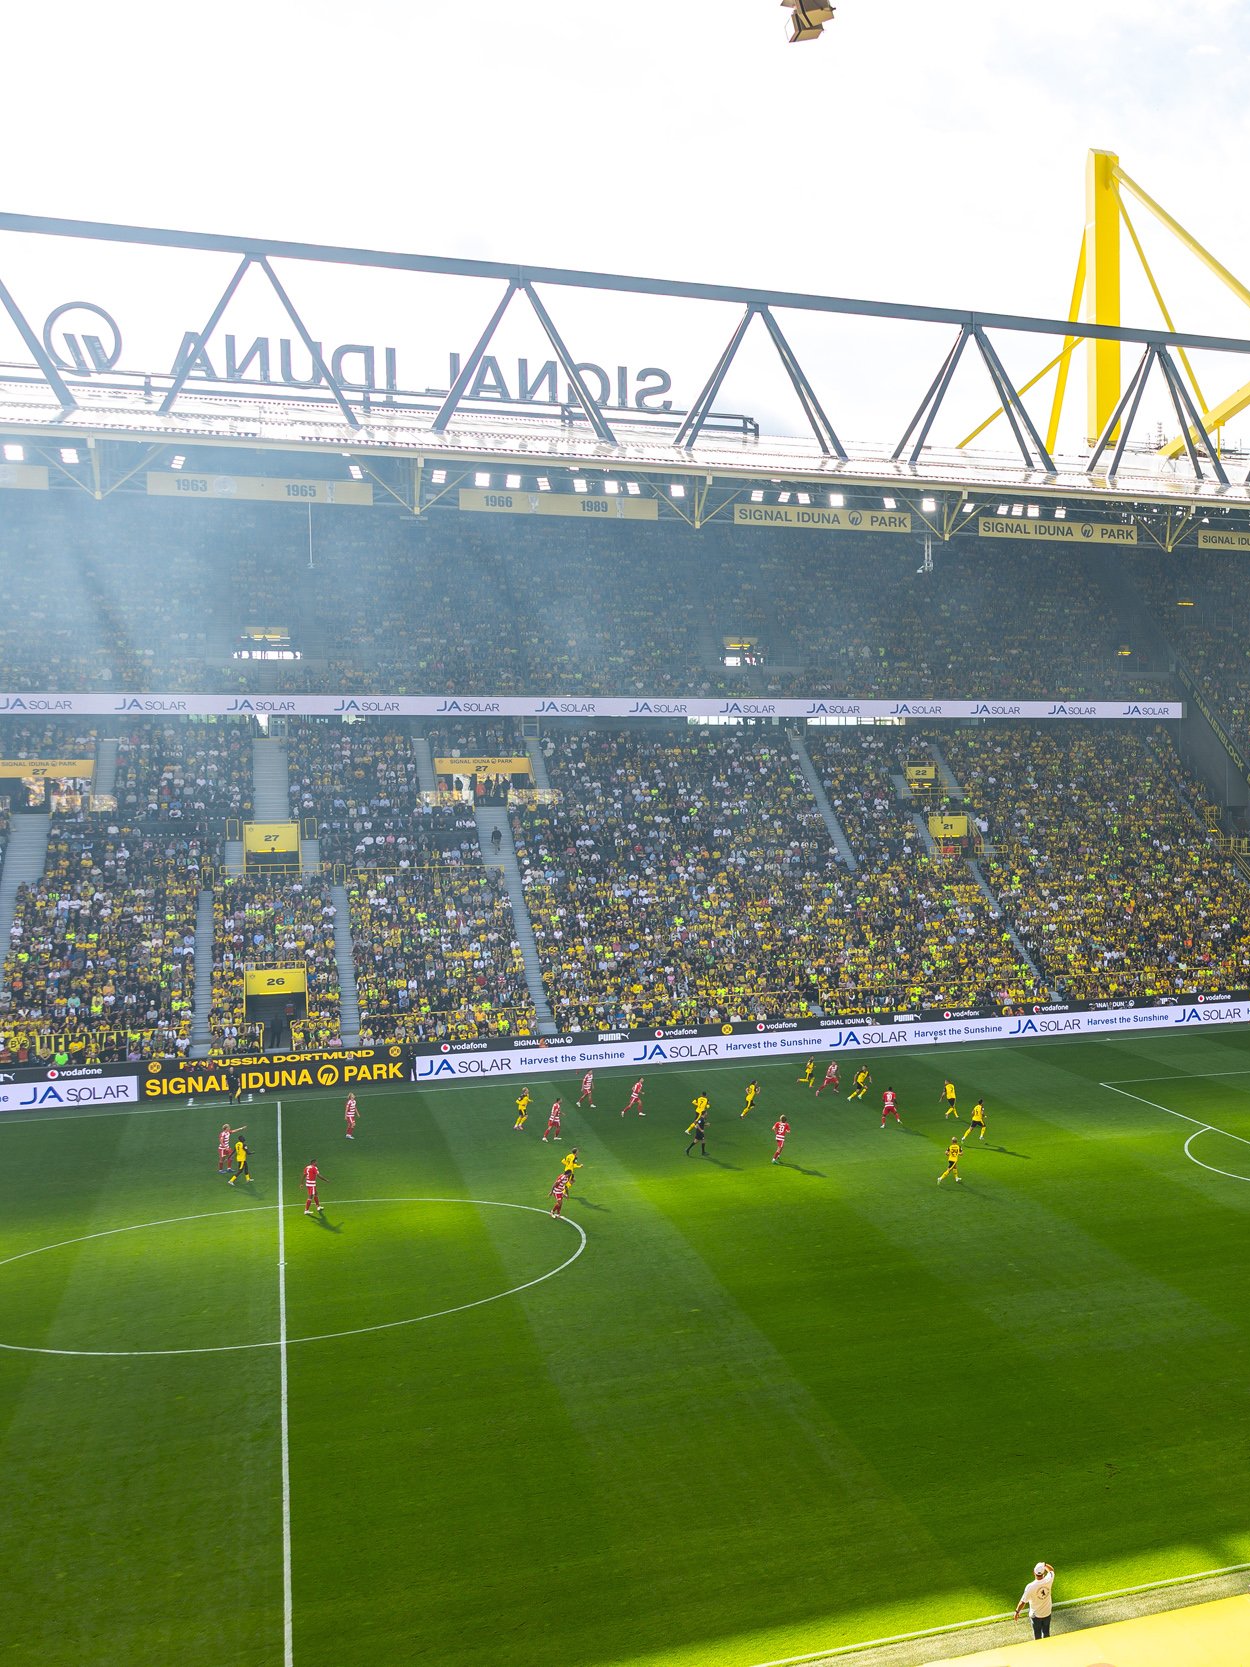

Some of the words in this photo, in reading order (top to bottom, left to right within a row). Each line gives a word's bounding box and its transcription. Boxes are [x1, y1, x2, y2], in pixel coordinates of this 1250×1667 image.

[175, 478, 208, 494] 1963
[285, 482, 317, 499] 1965
[484, 495, 513, 509] 1966
[580, 499, 609, 513] 1989
[739, 508, 793, 523] SIGNAL
[796, 511, 840, 525] IDUNA
[870, 515, 908, 528] PARK
[982, 521, 1031, 535] SIGNAL
[1034, 523, 1073, 537] IDUNA
[1100, 528, 1134, 540] PARK
[1202, 534, 1236, 546] SIGNAL
[29, 700, 72, 710] SOLAR
[115, 699, 142, 710] JA
[141, 700, 187, 711] SOLAR
[334, 700, 361, 711] JA
[361, 701, 400, 711] SOLAR
[436, 700, 462, 711] JA
[463, 702, 499, 712] SOLAR
[535, 701, 560, 712] JA
[561, 703, 595, 712] SOLAR
[629, 701, 652, 713] JA
[653, 704, 687, 713] SOLAR
[719, 702, 742, 713] JA
[743, 704, 775, 714] SOLAR
[806, 703, 828, 714] JA
[829, 705, 860, 714] SOLAR
[890, 704, 911, 714] JA
[912, 706, 942, 714] SOLAR
[970, 704, 990, 715] JA
[991, 707, 1020, 715] SOLAR
[1048, 704, 1067, 715] JA
[1068, 706, 1096, 715] SOLAR
[1123, 705, 1141, 715] JA
[1142, 707, 1169, 715] SOLAR
[264, 834, 279, 842] 27
[267, 977, 286, 986] 26
[1205, 993, 1231, 1001] vodafone
[1041, 1004, 1069, 1012] vodafone
[894, 1013, 913, 1022] PUMA
[1087, 1016, 1117, 1026] Harvest
[1133, 1013, 1169, 1023] Sunshine
[1175, 1008, 1201, 1023] JA
[1203, 1008, 1241, 1021] SOLAR
[766, 1021, 797, 1030] vodafone
[820, 1018, 844, 1027] SIGNAL
[1009, 1019, 1038, 1035] JA
[1040, 1018, 1081, 1033] SOLAR
[598, 1033, 621, 1042] PUMA
[665, 1028, 698, 1037] vodafone
[914, 1029, 947, 1039] Harvest
[949, 1027, 962, 1036] the
[964, 1025, 1003, 1035] Sunshine
[725, 1041, 761, 1051] Harvest
[763, 1039, 778, 1048] the
[780, 1037, 822, 1047] Sunshine
[829, 1031, 861, 1048] JA
[863, 1030, 908, 1045] SOLAR
[452, 1041, 487, 1051] vodafone
[273, 1049, 375, 1063] DORTMUND
[519, 1054, 559, 1065] Harvest
[560, 1053, 577, 1063] the
[579, 1050, 626, 1061] Sunshine
[633, 1044, 668, 1062] JA
[669, 1043, 719, 1059] SOLAR
[61, 1067, 102, 1077] vodafone
[419, 1058, 456, 1076] JA
[458, 1057, 512, 1074] SOLAR
[241, 1069, 313, 1090] IDUNA
[344, 1062, 404, 1082] PARK
[20, 1086, 64, 1106] JA
[66, 1085, 129, 1102] SOLAR
